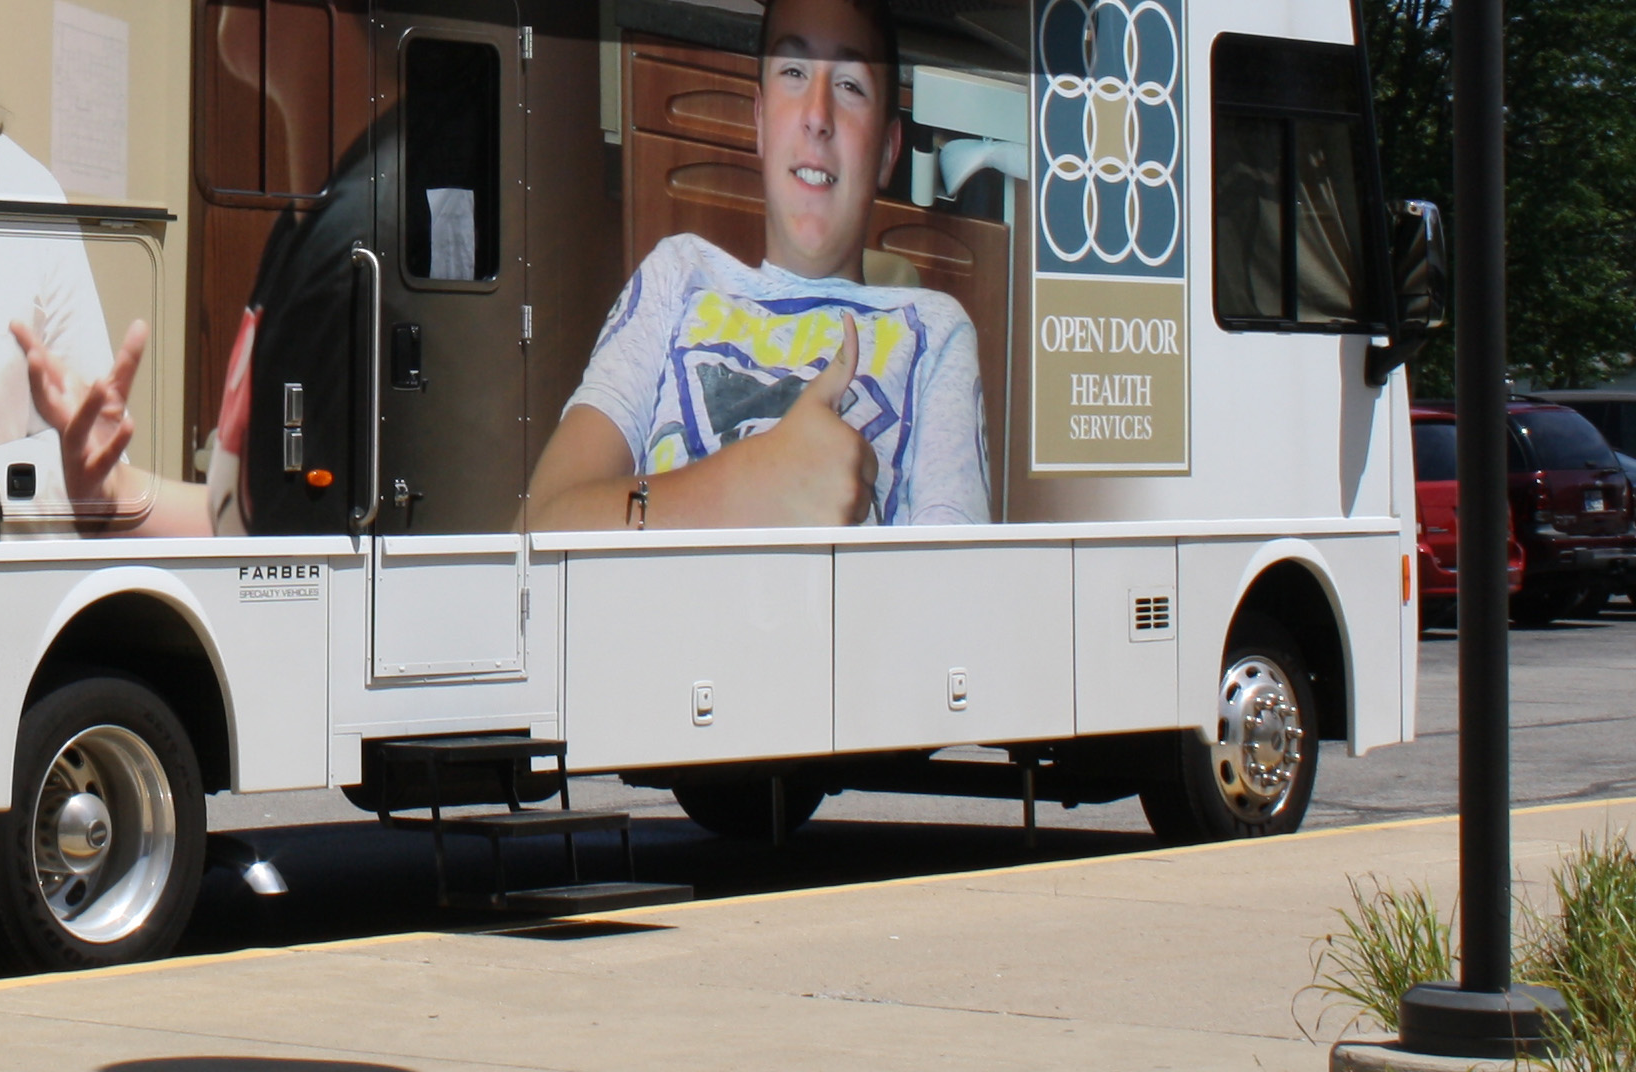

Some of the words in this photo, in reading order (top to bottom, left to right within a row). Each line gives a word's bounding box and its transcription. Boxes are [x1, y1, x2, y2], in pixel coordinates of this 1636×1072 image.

[1041, 315, 1105, 353] OPEN
[1109, 317, 1180, 355] DOOR
[1070, 374, 1152, 407] HEALTH
[1070, 415, 1152, 440] SERVICES
[239, 565, 320, 580] FARBER
[239, 589, 280, 599] SPECIALTY
[281, 587, 320, 598] VEHICLES
